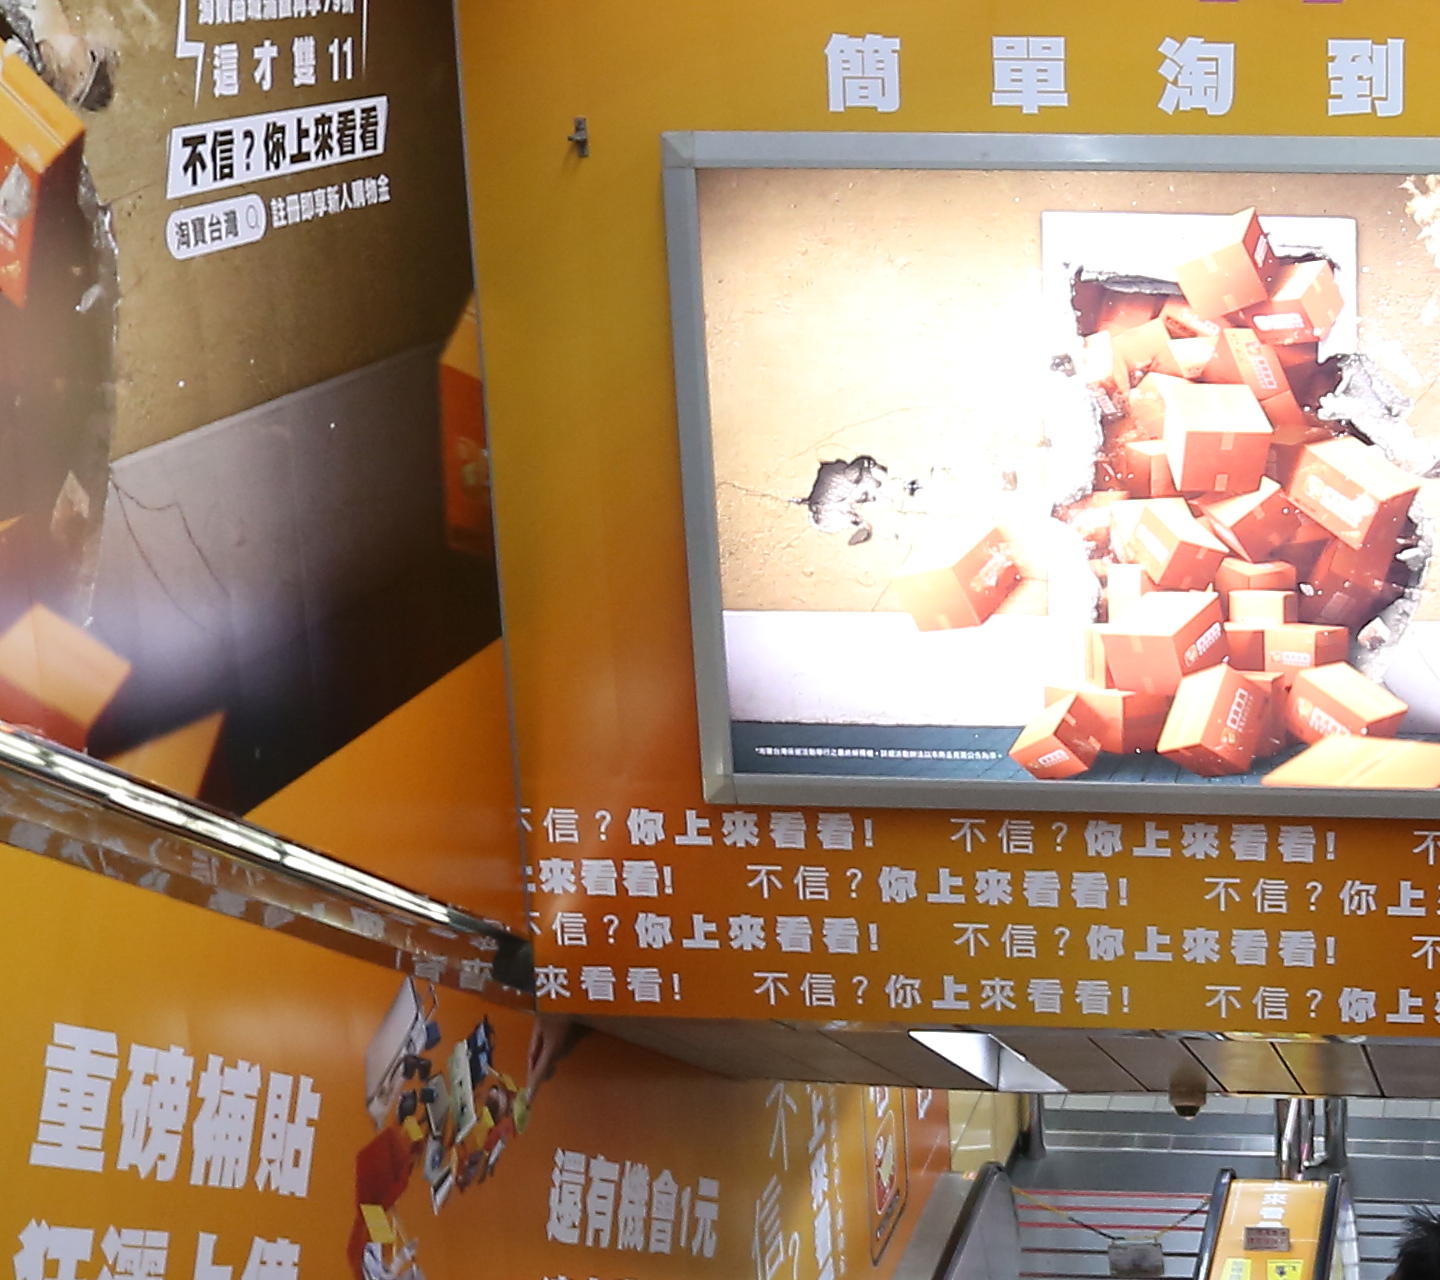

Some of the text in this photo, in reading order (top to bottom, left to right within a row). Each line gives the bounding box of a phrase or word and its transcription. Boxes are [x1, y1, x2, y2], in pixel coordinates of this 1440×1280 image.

[181, 105, 378, 186] 不信？你上來看看
[174, 209, 239, 250] 淘寶台灣
[29, 1022, 321, 1198] 重磅補貼
